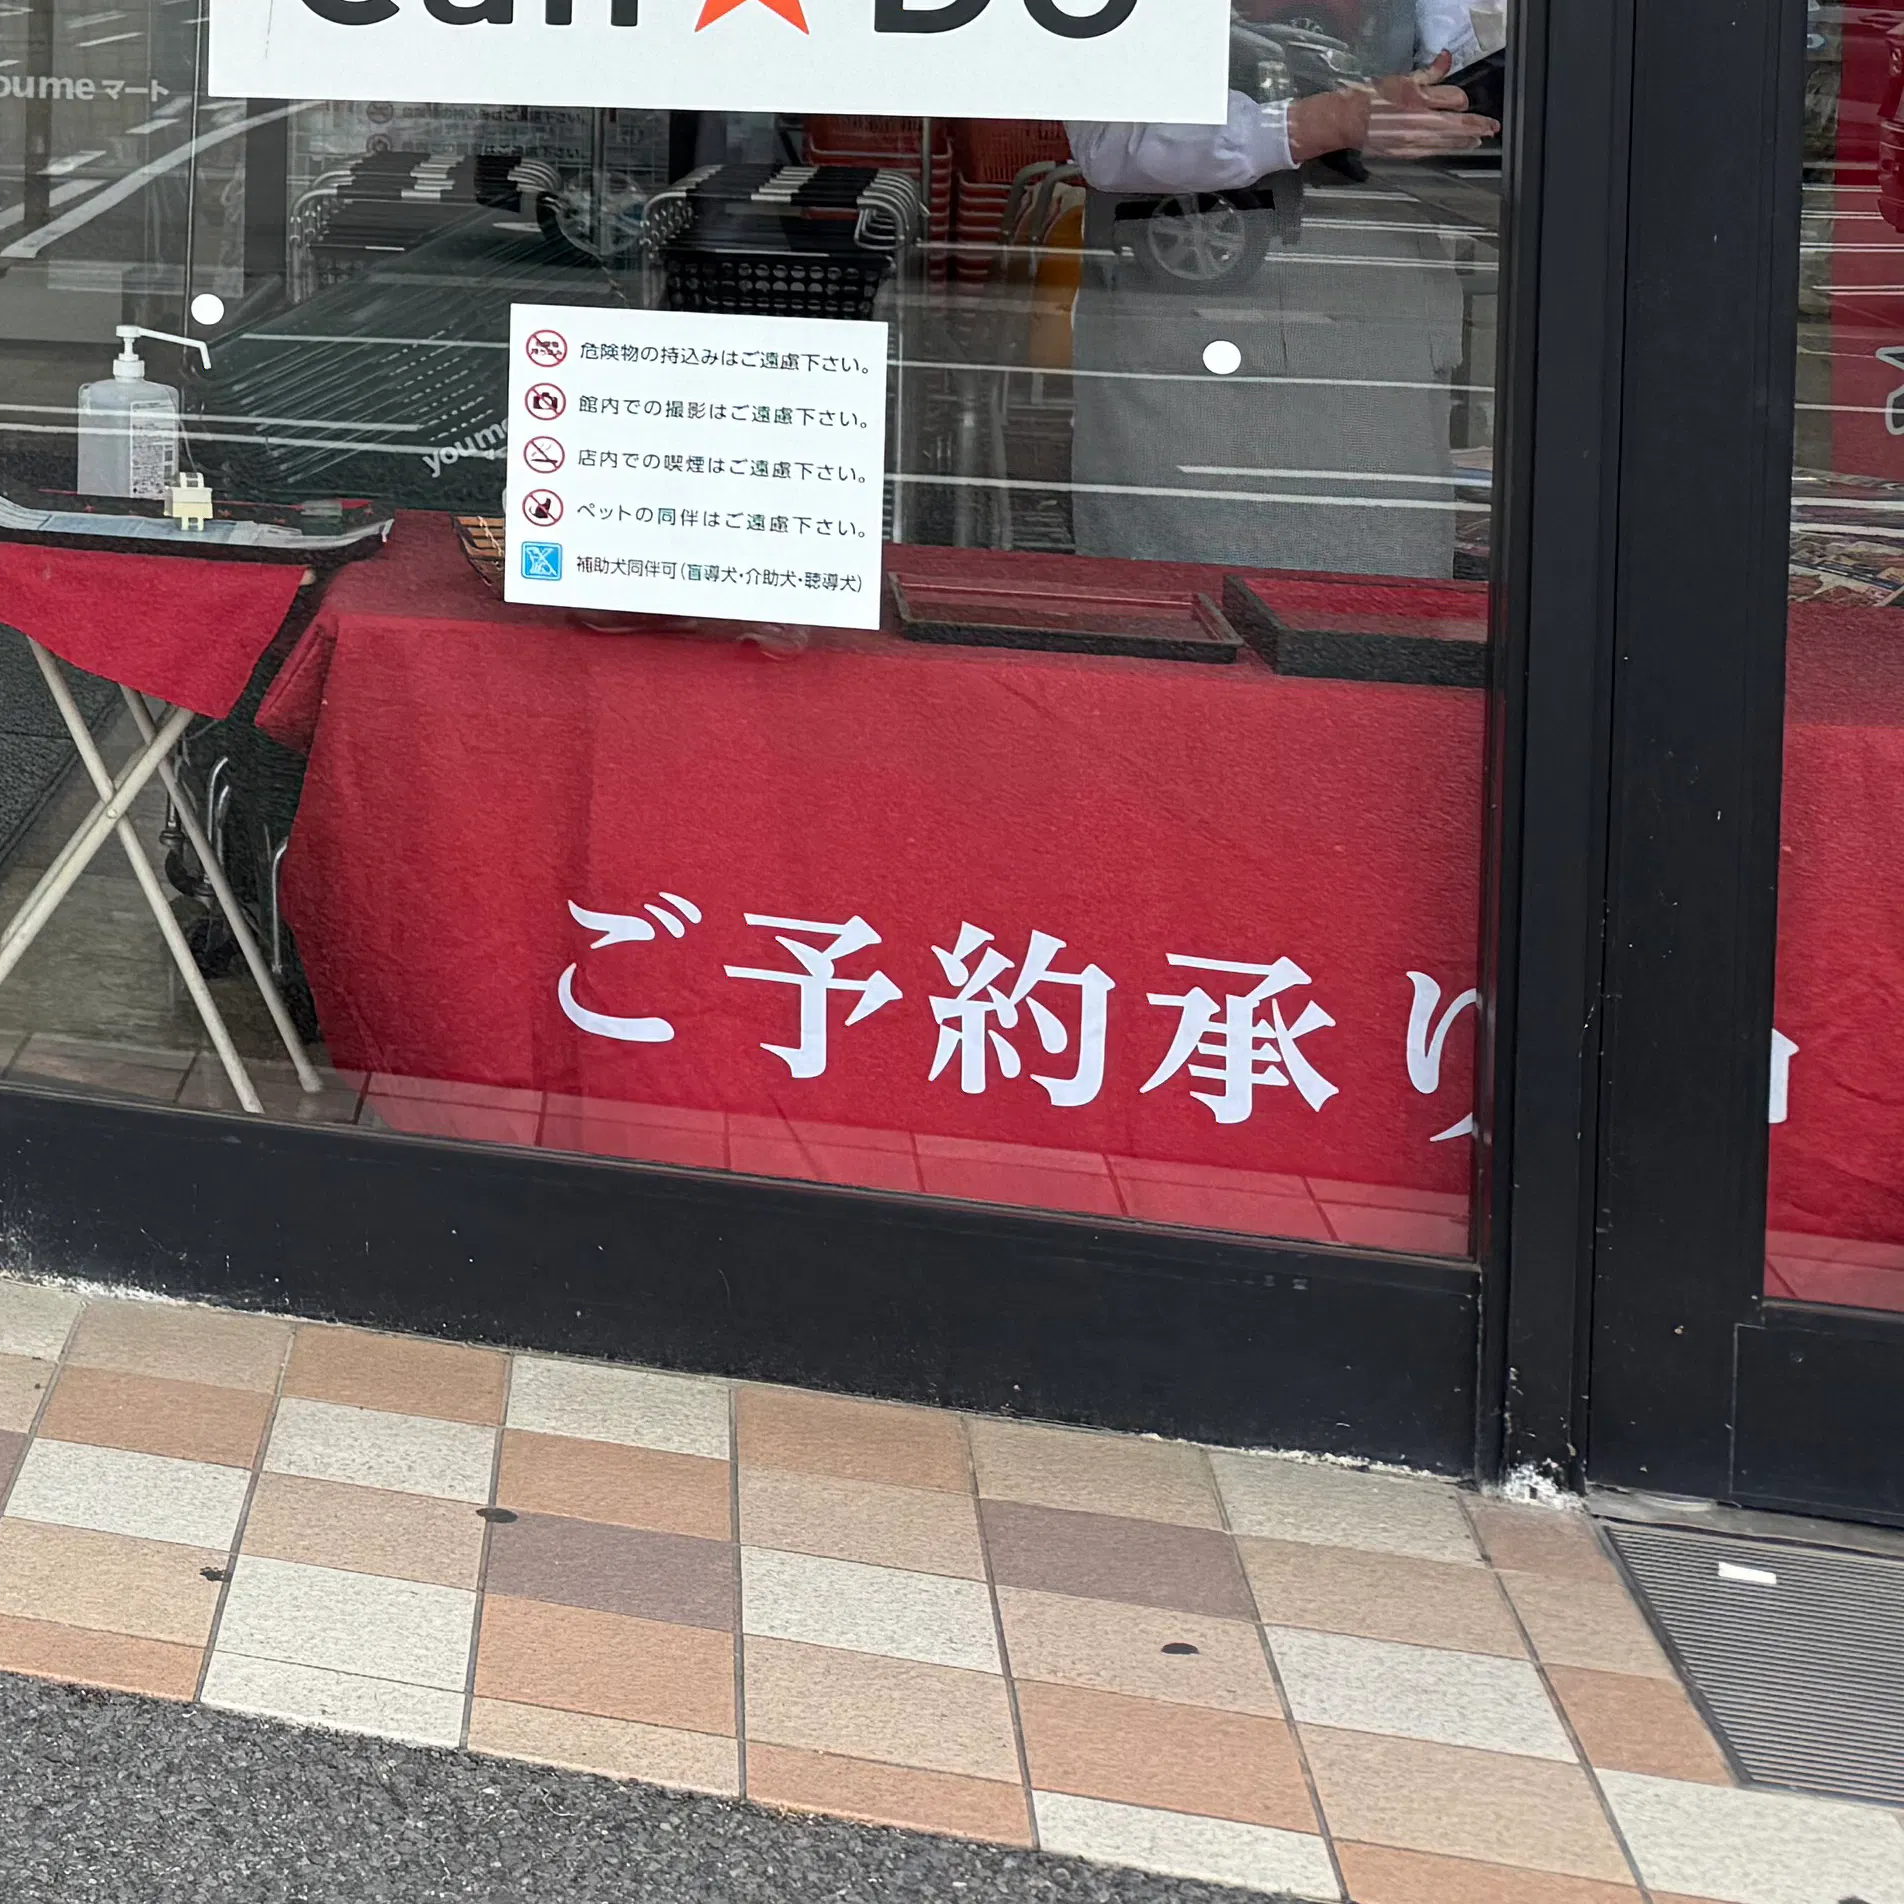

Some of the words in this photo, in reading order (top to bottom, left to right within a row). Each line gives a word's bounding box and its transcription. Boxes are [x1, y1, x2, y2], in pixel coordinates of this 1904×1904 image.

[101, 78, 170, 102] マート
[580, 341, 872, 376] 危険物の持込みはご遠慮下さい。
[578, 395, 869, 430] 館内での撮影はご遠慮下さい。
[577, 449, 867, 485] 店内での喫煙はご遠慮下さい。
[576, 502, 867, 540] ペットの同伴はご遠慮下さい。
